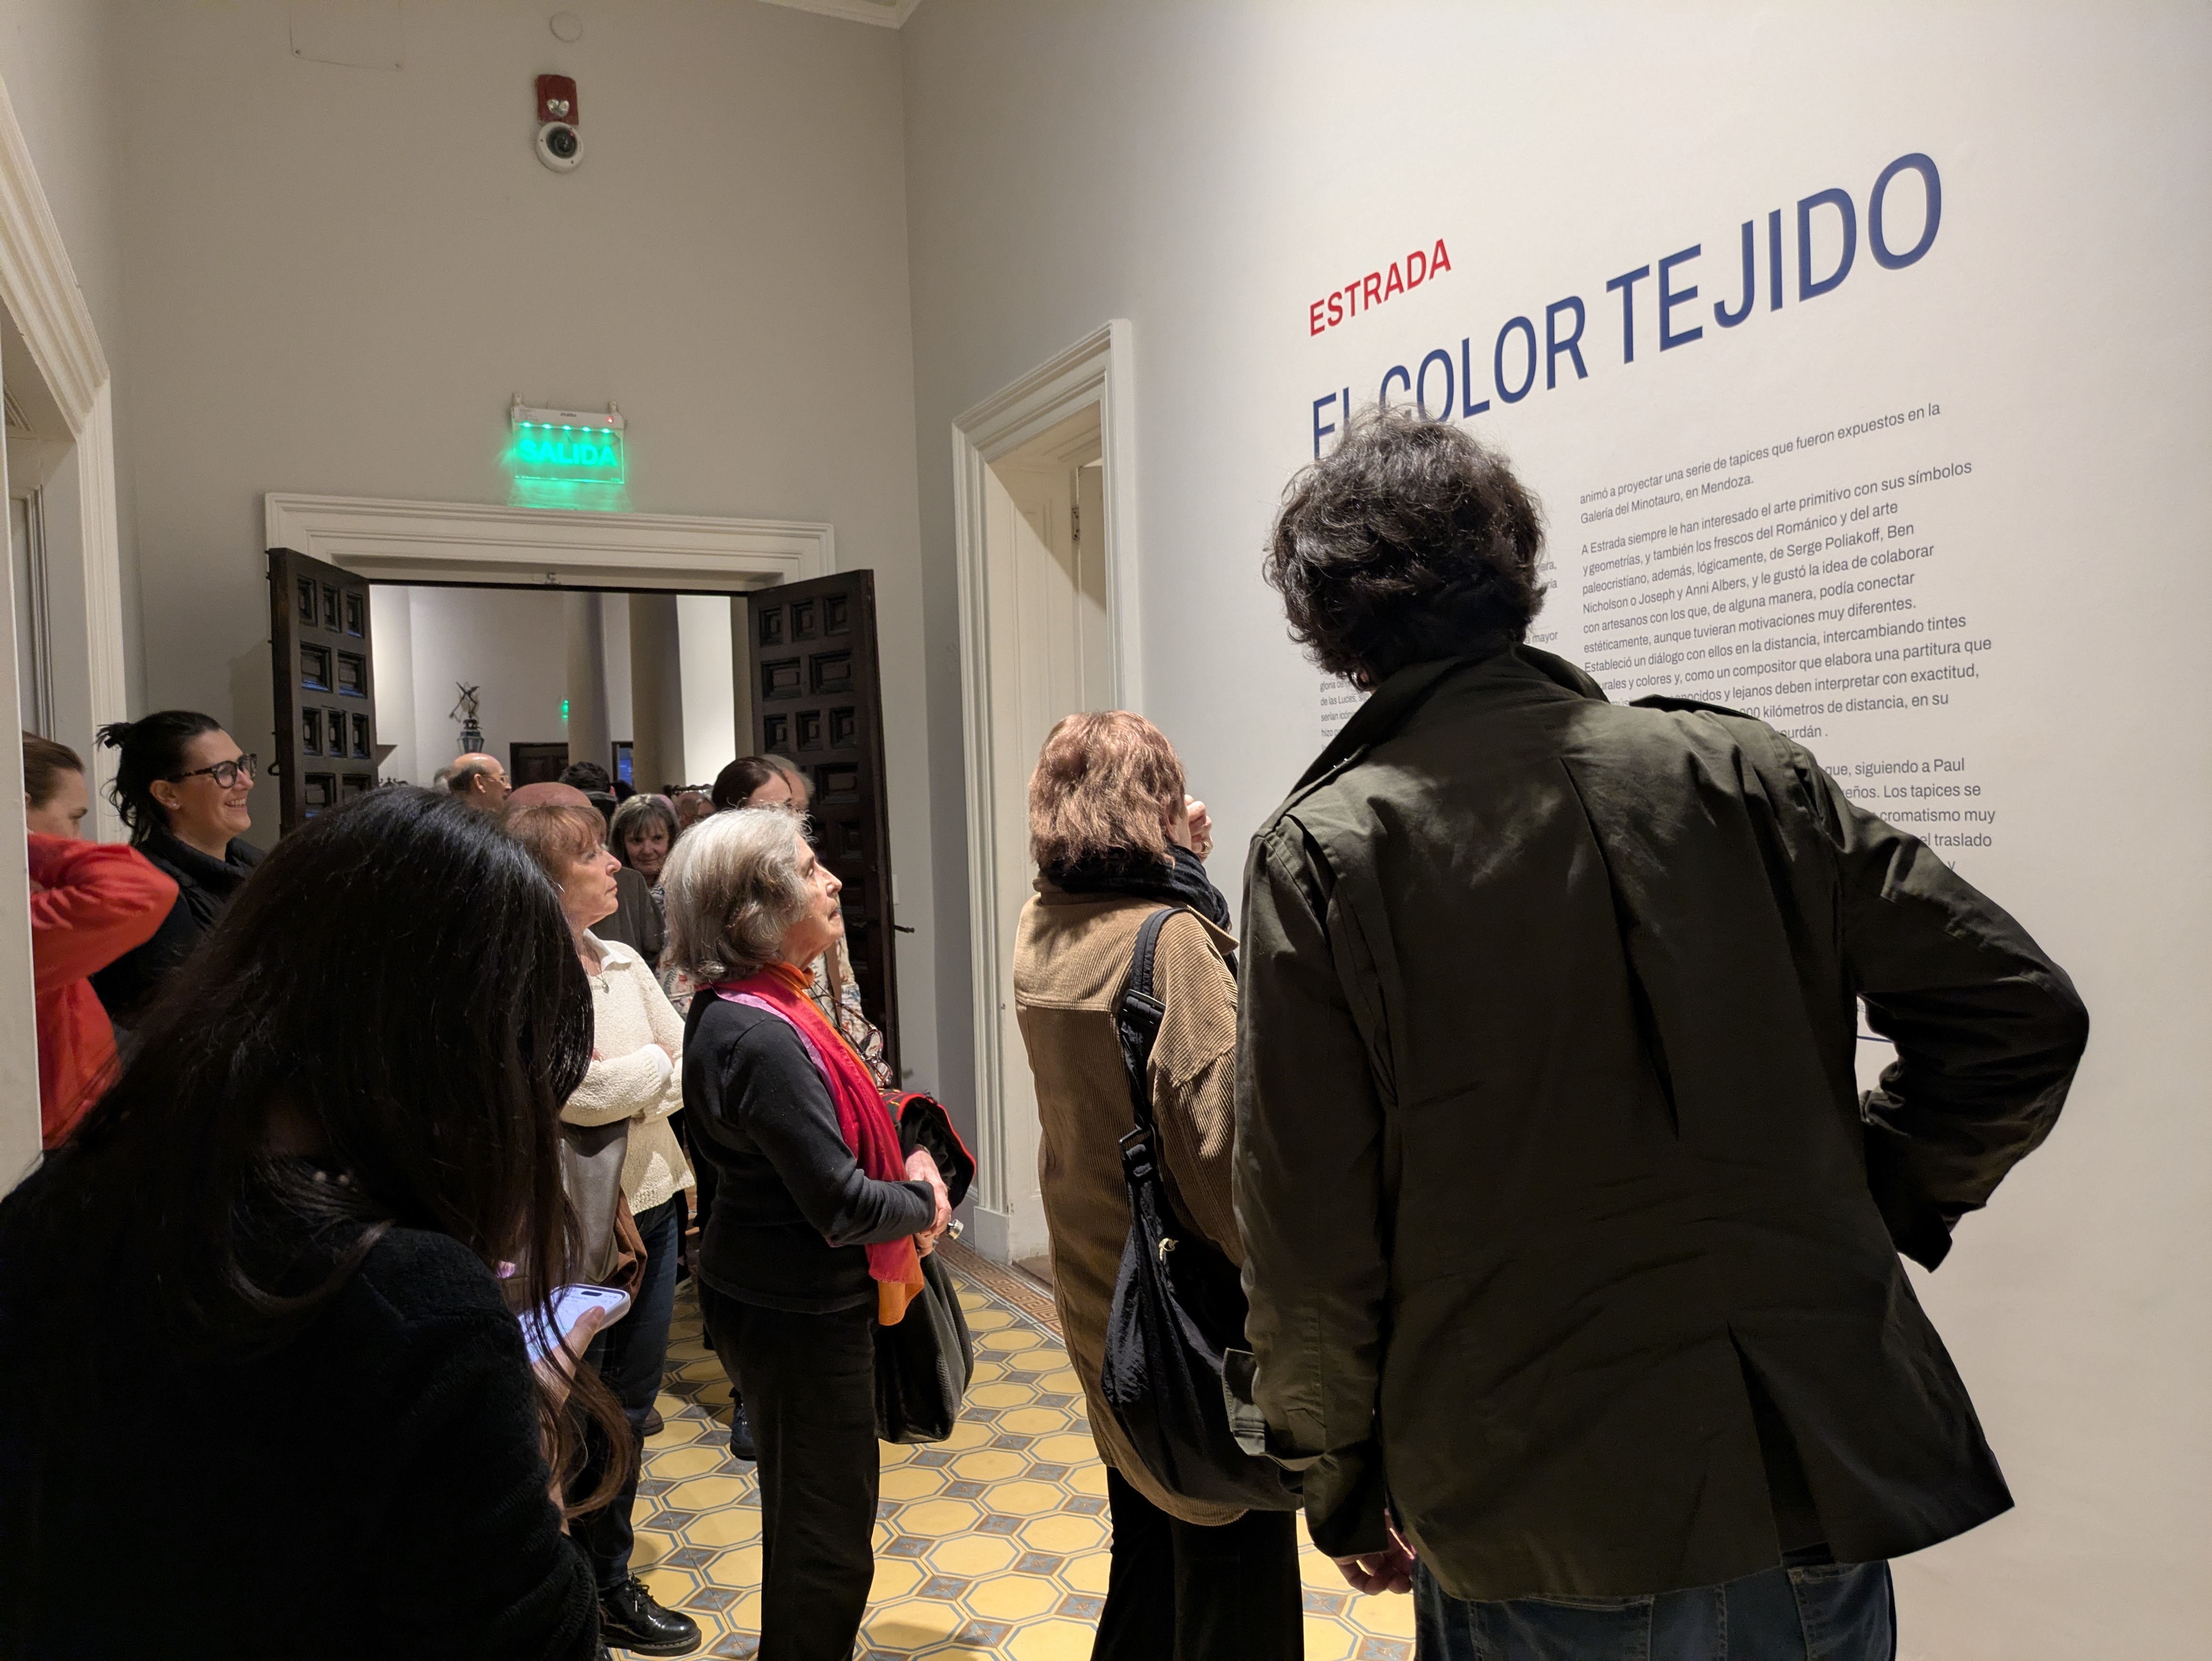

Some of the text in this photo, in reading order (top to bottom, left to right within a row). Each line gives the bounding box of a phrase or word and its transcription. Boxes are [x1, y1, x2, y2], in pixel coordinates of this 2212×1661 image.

[1310, 238, 1452, 336] ESTRADA
[1379, 295, 1589, 421] COLOR
[1606, 152, 1942, 365] TEJIDO
[519, 439, 618, 467] SALIDA
[1580, 402, 1941, 505] animó a proyectar una serie de tapices que fueron expuestos en la
[1581, 475, 1754, 524] Galería del Minotauro, en Mendoza.
[1581, 462, 1972, 555] A Estrada siempre le han interesado el arte primitivo con sus símbolos
[1582, 502, 1898, 577] y geometrías, y también los frescos del Románico y del arte
[1582, 524, 1914, 597] paleocristiano, además, lógicamente, de Serge Poliakoff, Ben
[1583, 545, 1935, 614] Nicholson o Joseph y Anni Albers, y le gustó la idea de colaborar
[1583, 573, 1915, 634] con artesanos con los que, de alguna manera, podía conectar
[1532, 631, 1558, 644] mayor
[1583, 598, 1916, 653] estéticamente, aunque tuvieran motivaciones muy diferentes.
[1585, 616, 1967, 673] Estableció un diálogo con ellos en la distancia, intercambiando tintes
[1320, 681, 1336, 693] gloria
[1628, 679, 1634, 690] y
[1636, 674, 1672, 687] colores
[1674, 674, 1682, 686] y,
[1684, 670, 1714, 682] como
[1716, 668, 1731, 679] un
[1732, 659, 1797, 677] compositor
[1799, 657, 1822, 672] que
[1825, 652, 1872, 667] elabora
[1875, 649, 1900, 662] una
[1902, 642, 1961, 662] partitura
[1964, 639, 1992, 655] que
[1724, 690, 1730, 702] y
[1733, 686, 1773, 701] lejanos
[1775, 681, 1812, 695] deben
[1814, 674, 1880, 691] interpretar
[1882, 673, 1907, 685] con
[1910, 663, 1979, 683] exactitud,
[1320, 698, 1328, 706] de
[1328, 697, 1338, 706] las
[1763, 703, 1825, 718] kilómetros
[1827, 700, 1843, 714] de
[1845, 695, 1908, 712] distancia,
[1911, 695, 1929, 707] en
[1932, 694, 1949, 706] su
[1321, 728, 1333, 737] hizo
[1855, 759, 1919, 778] siguiendo
[1921, 762, 1931, 773] a
[1934, 757, 1965, 772] Paul
[1883, 785, 1908, 798] Los
[1910, 783, 1961, 800] tapices
[1964, 785, 1981, 797] se
[1880, 808, 1996, 825] cromatismo muy
[1934, 832, 1992, 847] traslado
